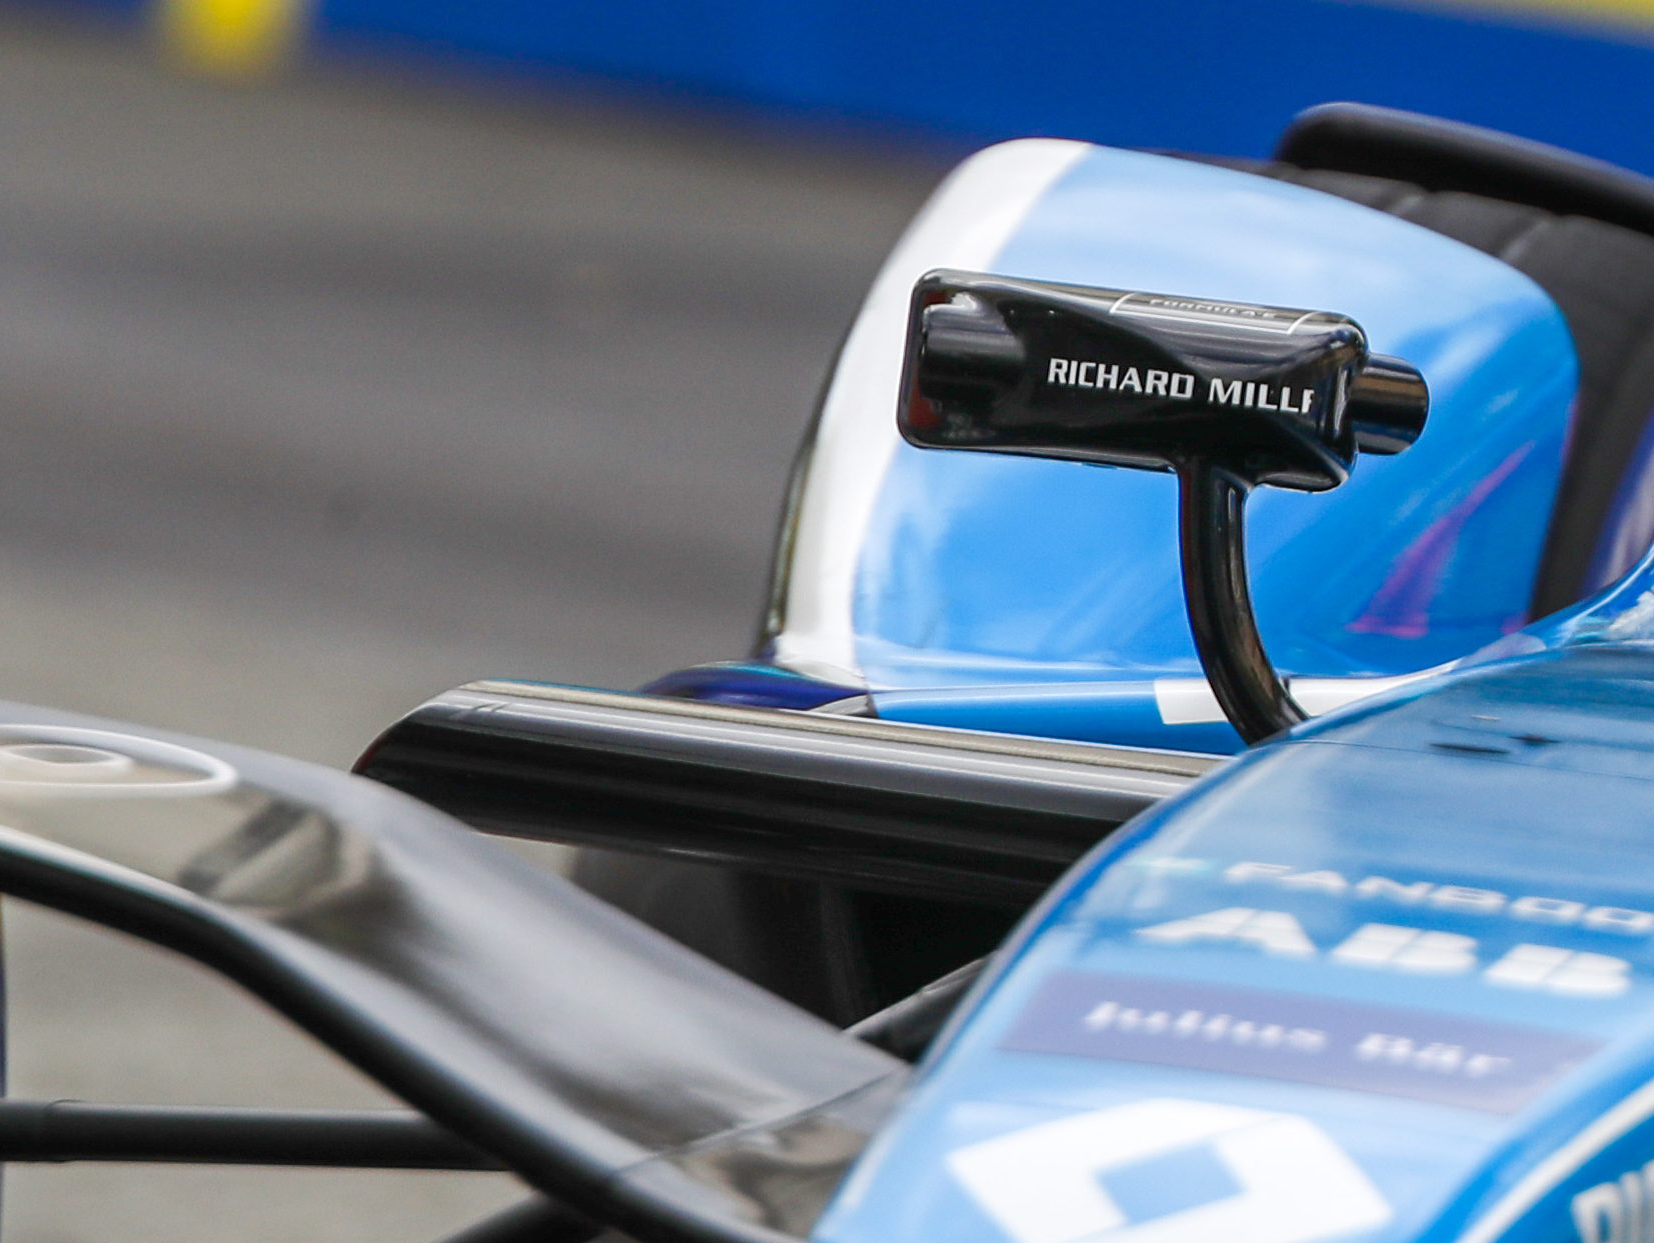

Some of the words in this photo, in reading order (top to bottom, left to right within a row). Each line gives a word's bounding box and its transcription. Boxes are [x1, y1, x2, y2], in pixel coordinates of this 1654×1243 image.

[1047, 357, 1195, 400] RICHARD
[1133, 907, 1632, 995] ABB
[1082, 1000, 1329, 1054] Julius
